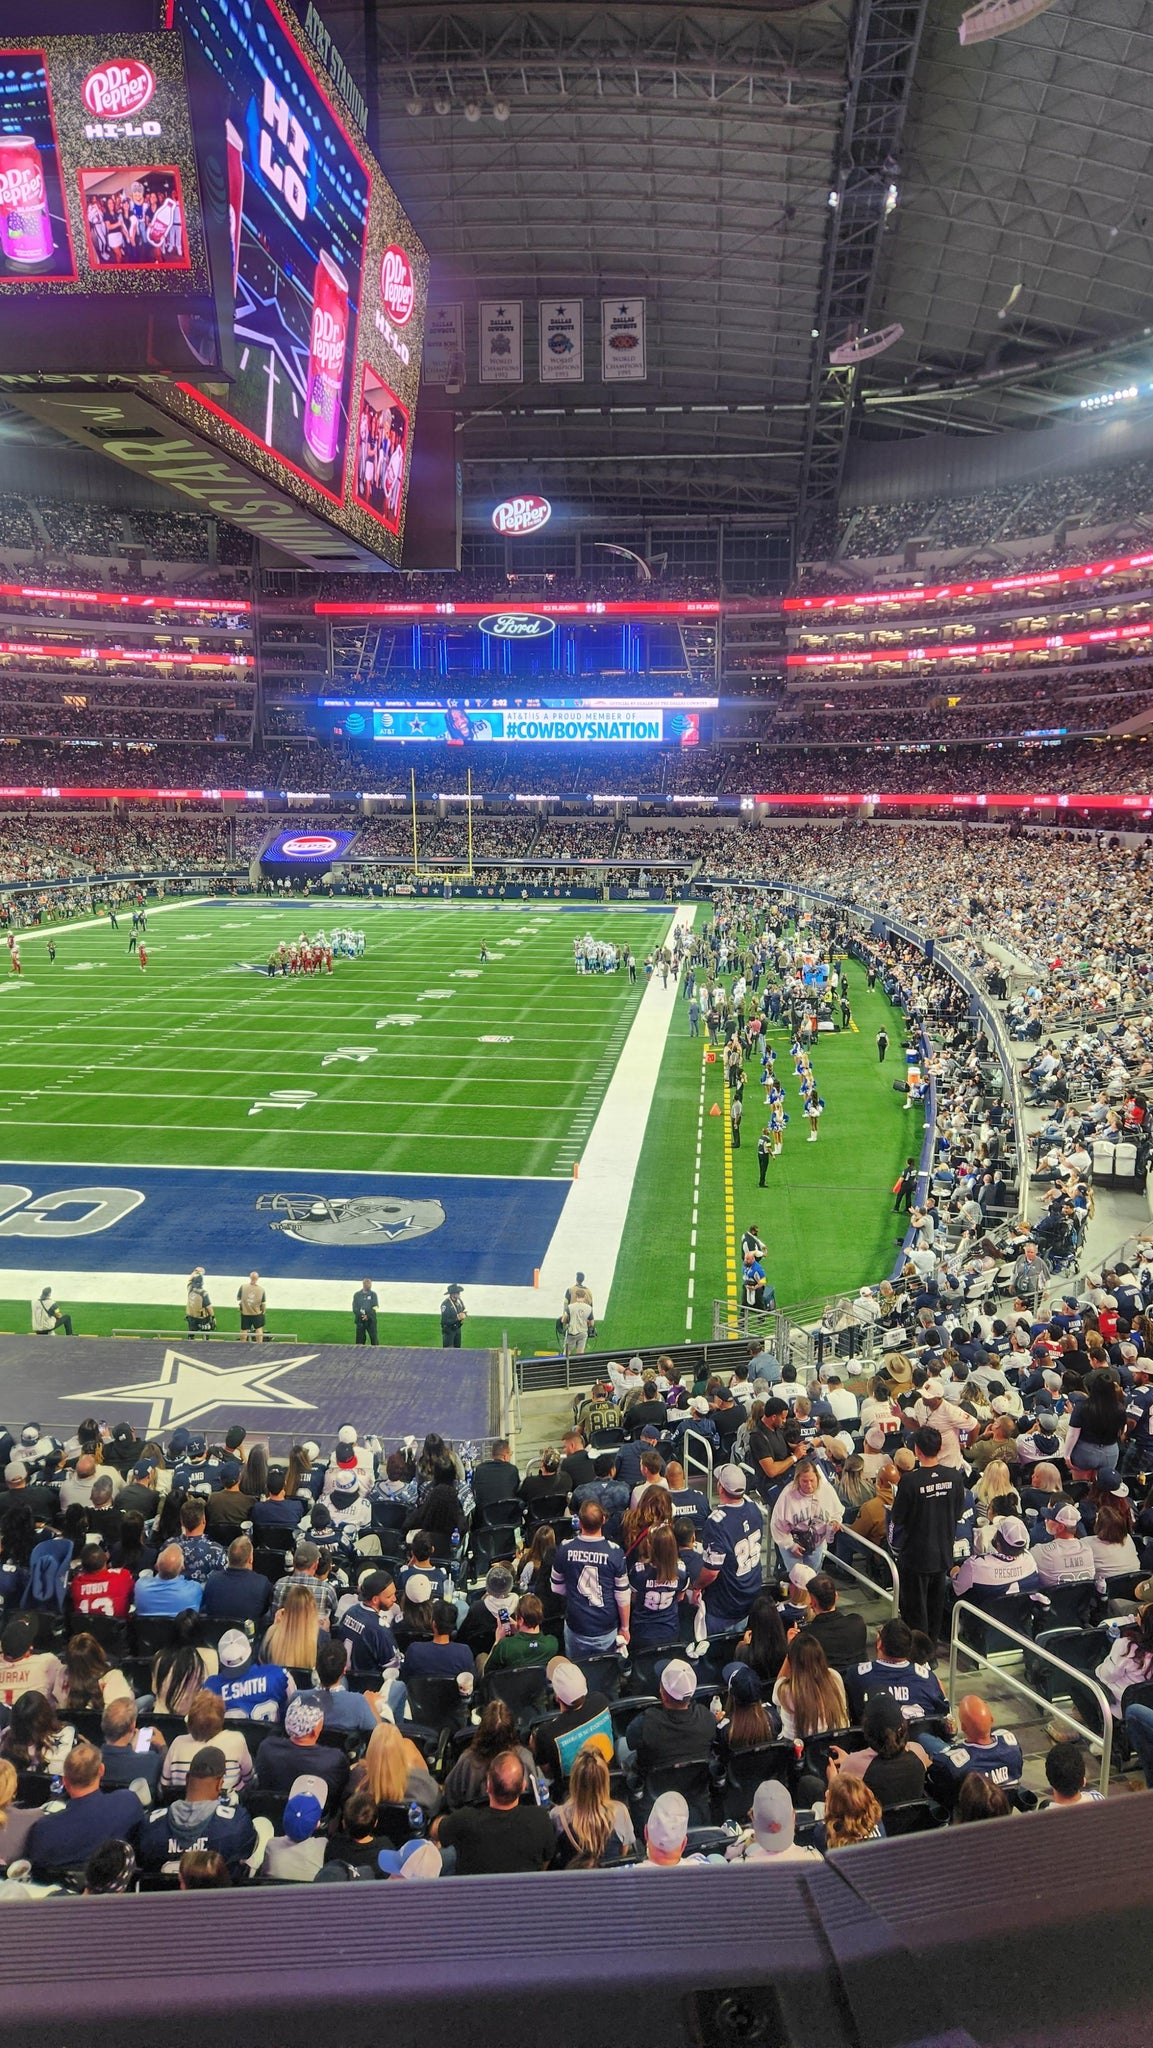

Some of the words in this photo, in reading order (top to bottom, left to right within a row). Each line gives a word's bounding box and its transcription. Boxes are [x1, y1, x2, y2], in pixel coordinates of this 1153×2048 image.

[106, 66, 131, 90] Dr
[304, 1, 331, 66] AT&T
[330, 45, 368, 137] STADIUM
[85, 72, 147, 113] Pepper
[85, 121, 161, 139] HI-LO
[263, 76, 310, 177] HI
[5, 168, 31, 182] Dr
[260, 129, 307, 221] LO
[393, 254, 406, 283] Dr
[382, 251, 411, 311] Pepper
[322, 312, 339, 340] Dr
[313, 307, 344, 370] Pepper
[375, 310, 409, 366] HI-LO
[492, 502, 547, 531] Pepper
[512, 499, 534, 514] Dr
[493, 615, 541, 635] Ford
[507, 712, 528, 720] AT&T
[544, 712, 550, 720] A
[552, 712, 578, 720] PROUD
[585, 712, 622, 721] MEMBER
[626, 712, 636, 720] OF
[506, 722, 659, 739] #COWBOYSNATION
[323, 1046, 379, 1063] 20
[253, 1089, 319, 1111] 10
[567, 1549, 609, 1565] PRESCOTT
[1064, 1555, 1084, 1569] LAMB
[994, 1566, 1023, 1579] PRESCOTT
[81, 1581, 109, 1595] PURDY
[576, 1565, 605, 1608] 4
